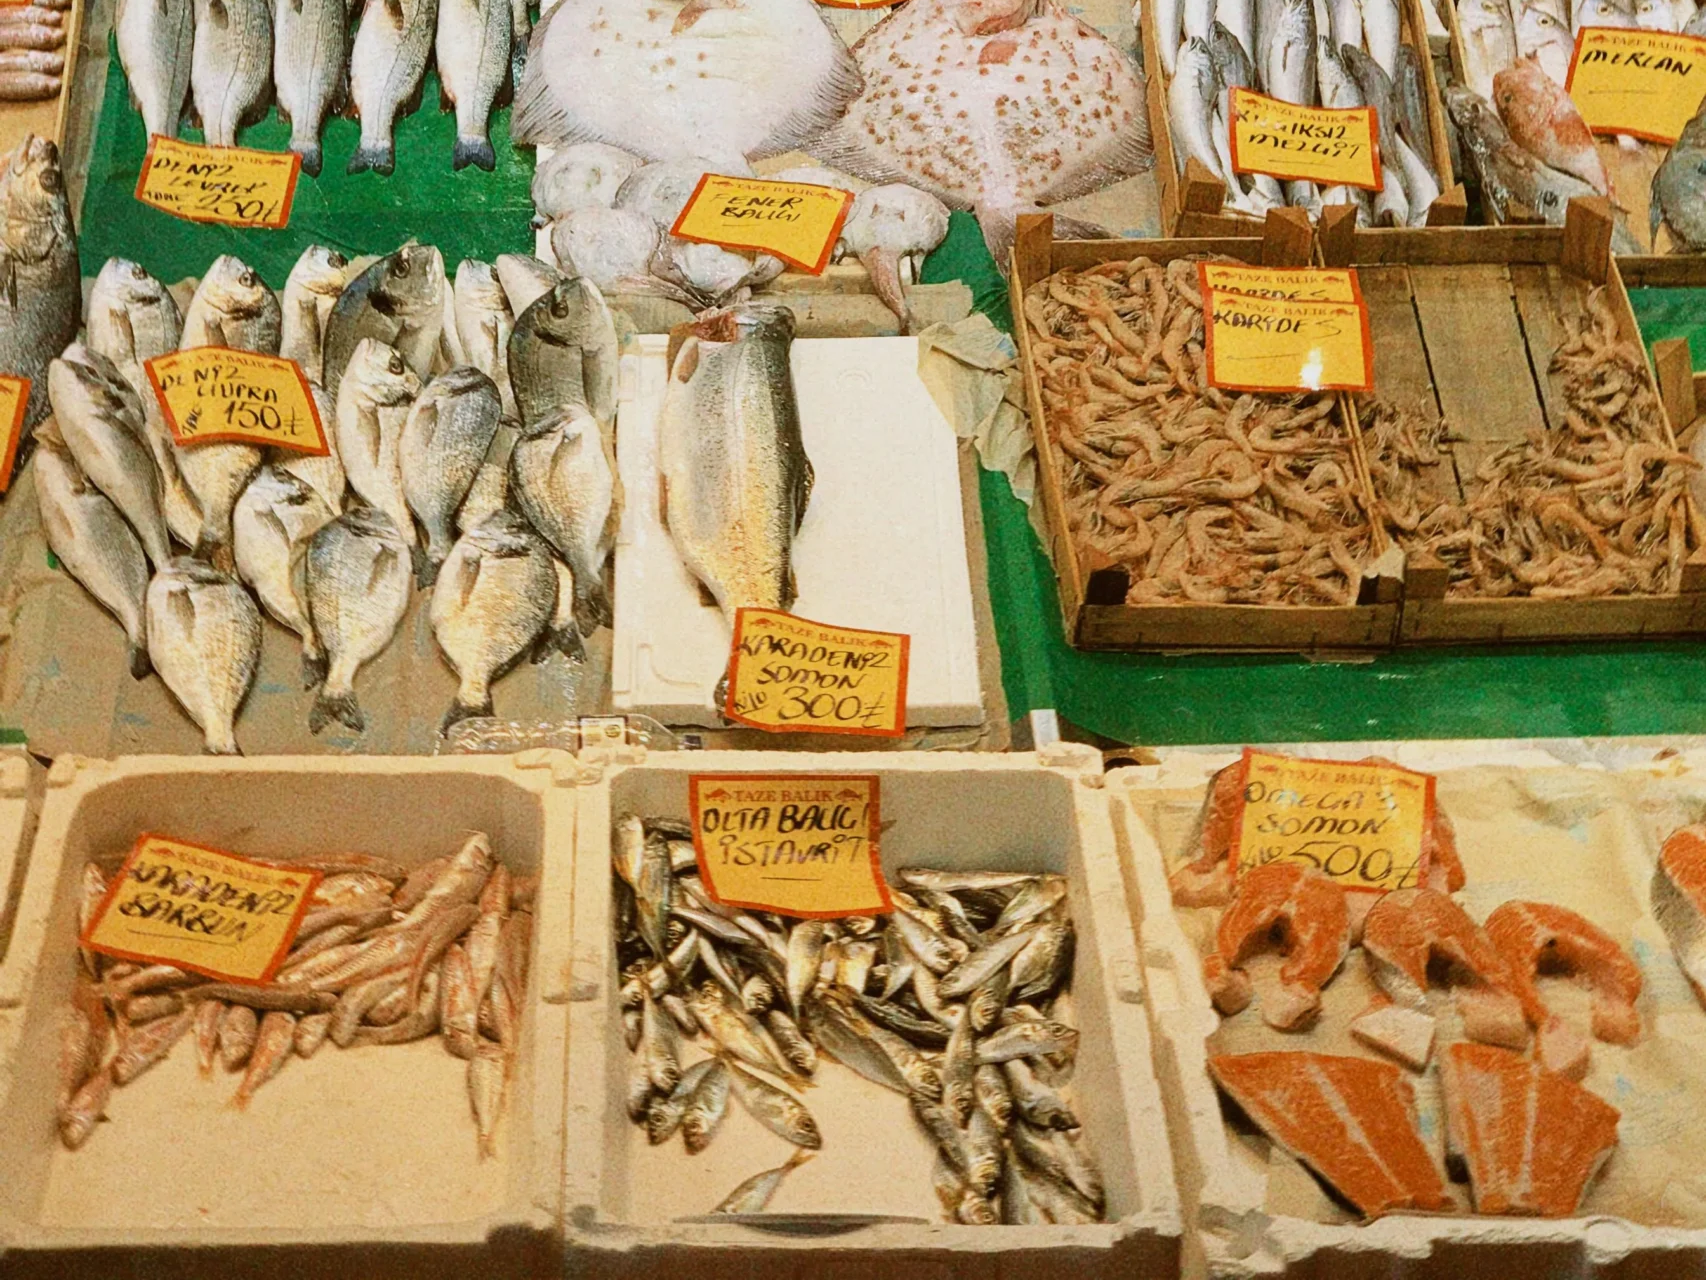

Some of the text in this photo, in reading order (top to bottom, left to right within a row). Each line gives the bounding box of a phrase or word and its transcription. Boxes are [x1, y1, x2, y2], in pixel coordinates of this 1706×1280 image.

[710, 193, 803, 209] FENER
[1236, 275, 1272, 284] TAZE
[1244, 301, 1327, 316] TAZE BALIK
[776, 622, 867, 646] TAZE BALIK
[756, 661, 867, 690] SOMON
[734, 790, 833, 802] TAZE BALIK
[702, 806, 770, 833] OLTA
[1257, 814, 1392, 837] SOMON
